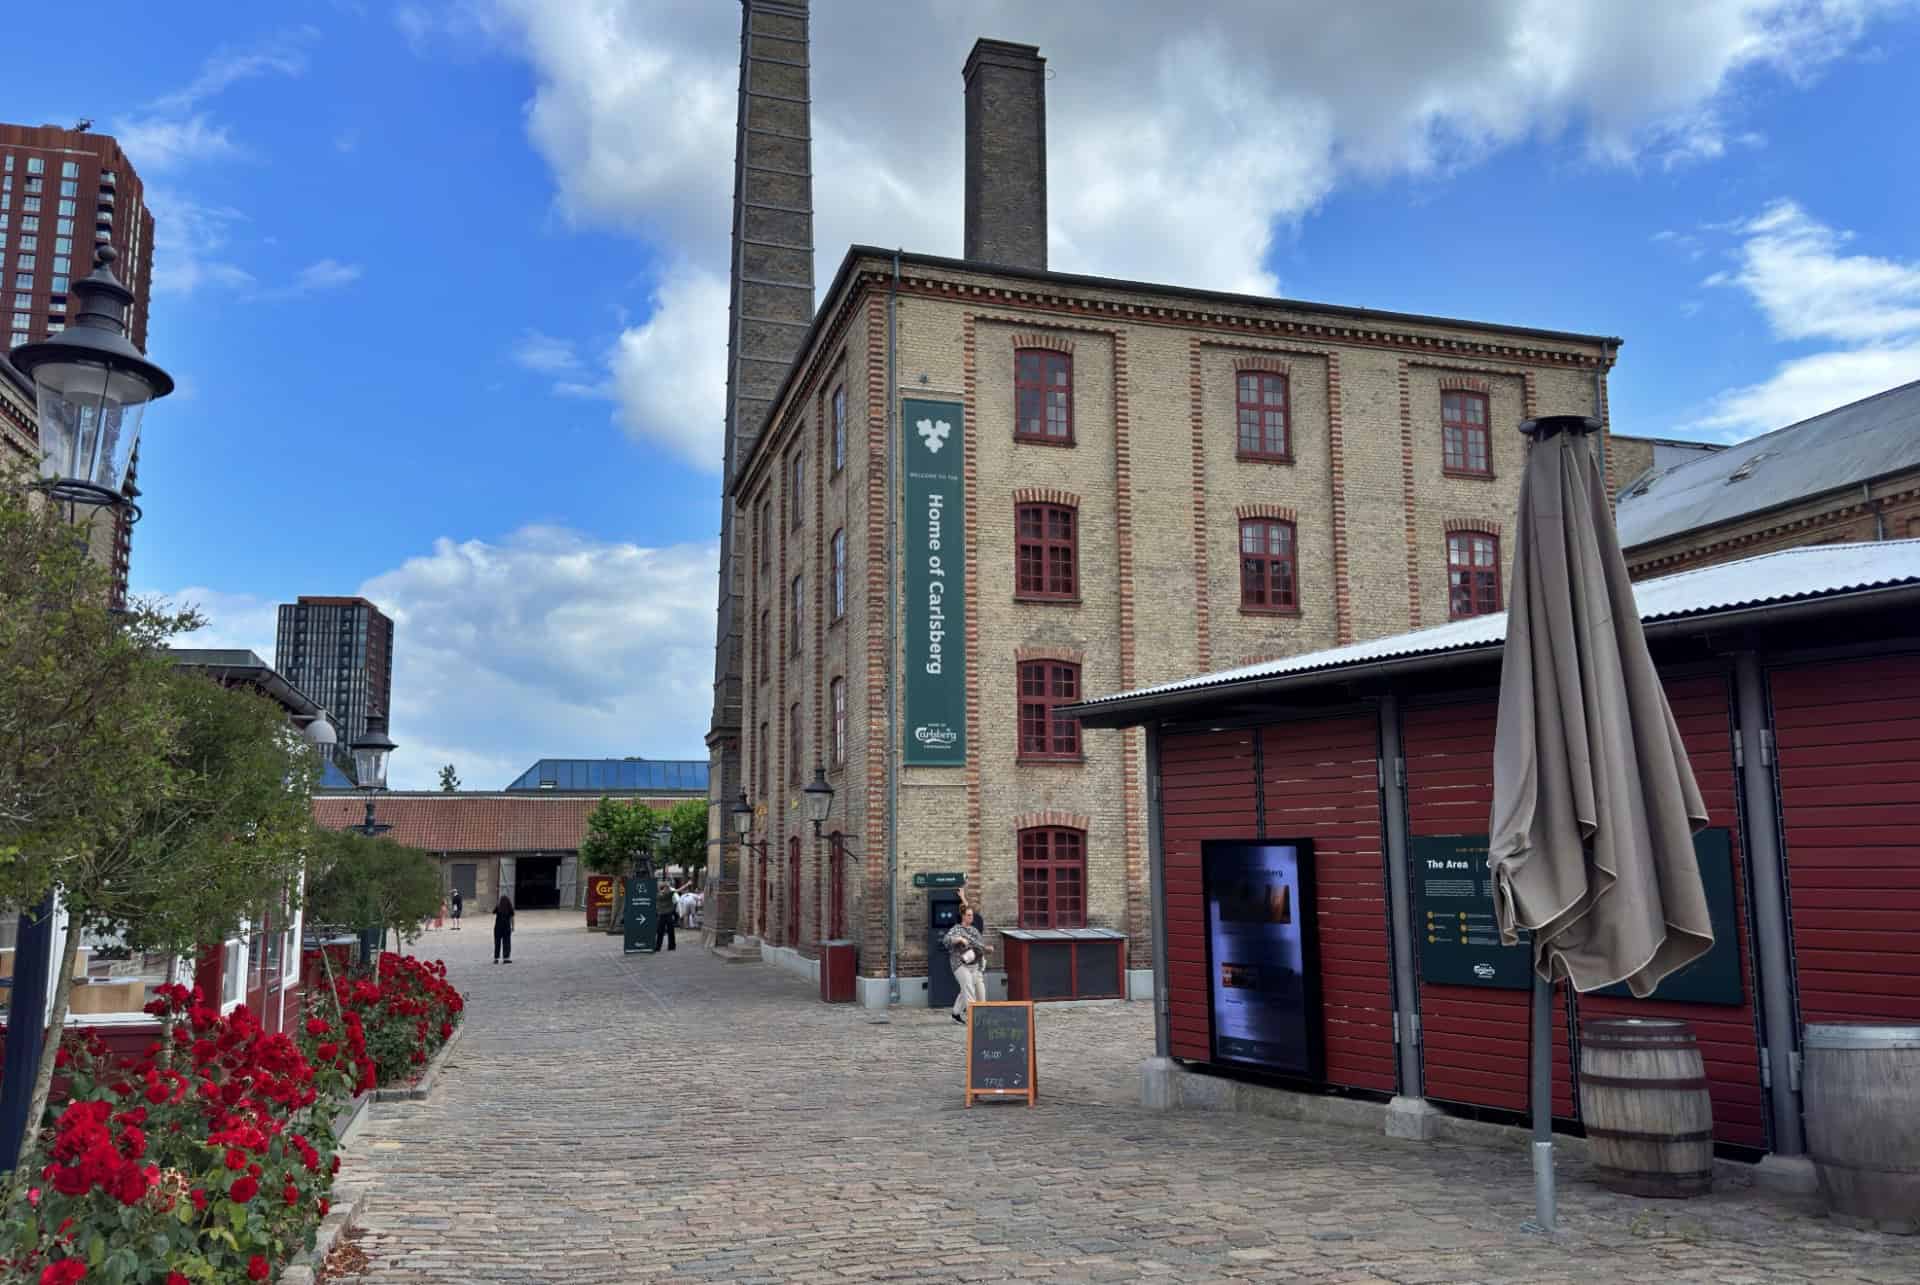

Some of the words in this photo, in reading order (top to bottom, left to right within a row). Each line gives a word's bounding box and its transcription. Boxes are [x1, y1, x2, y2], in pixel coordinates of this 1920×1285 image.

[928, 494, 944, 551] Home
[928, 556, 945, 577] of
[926, 581, 945, 675] Carlsberg
[1426, 859, 1444, 869] The
[1446, 859, 1469, 869] Area
